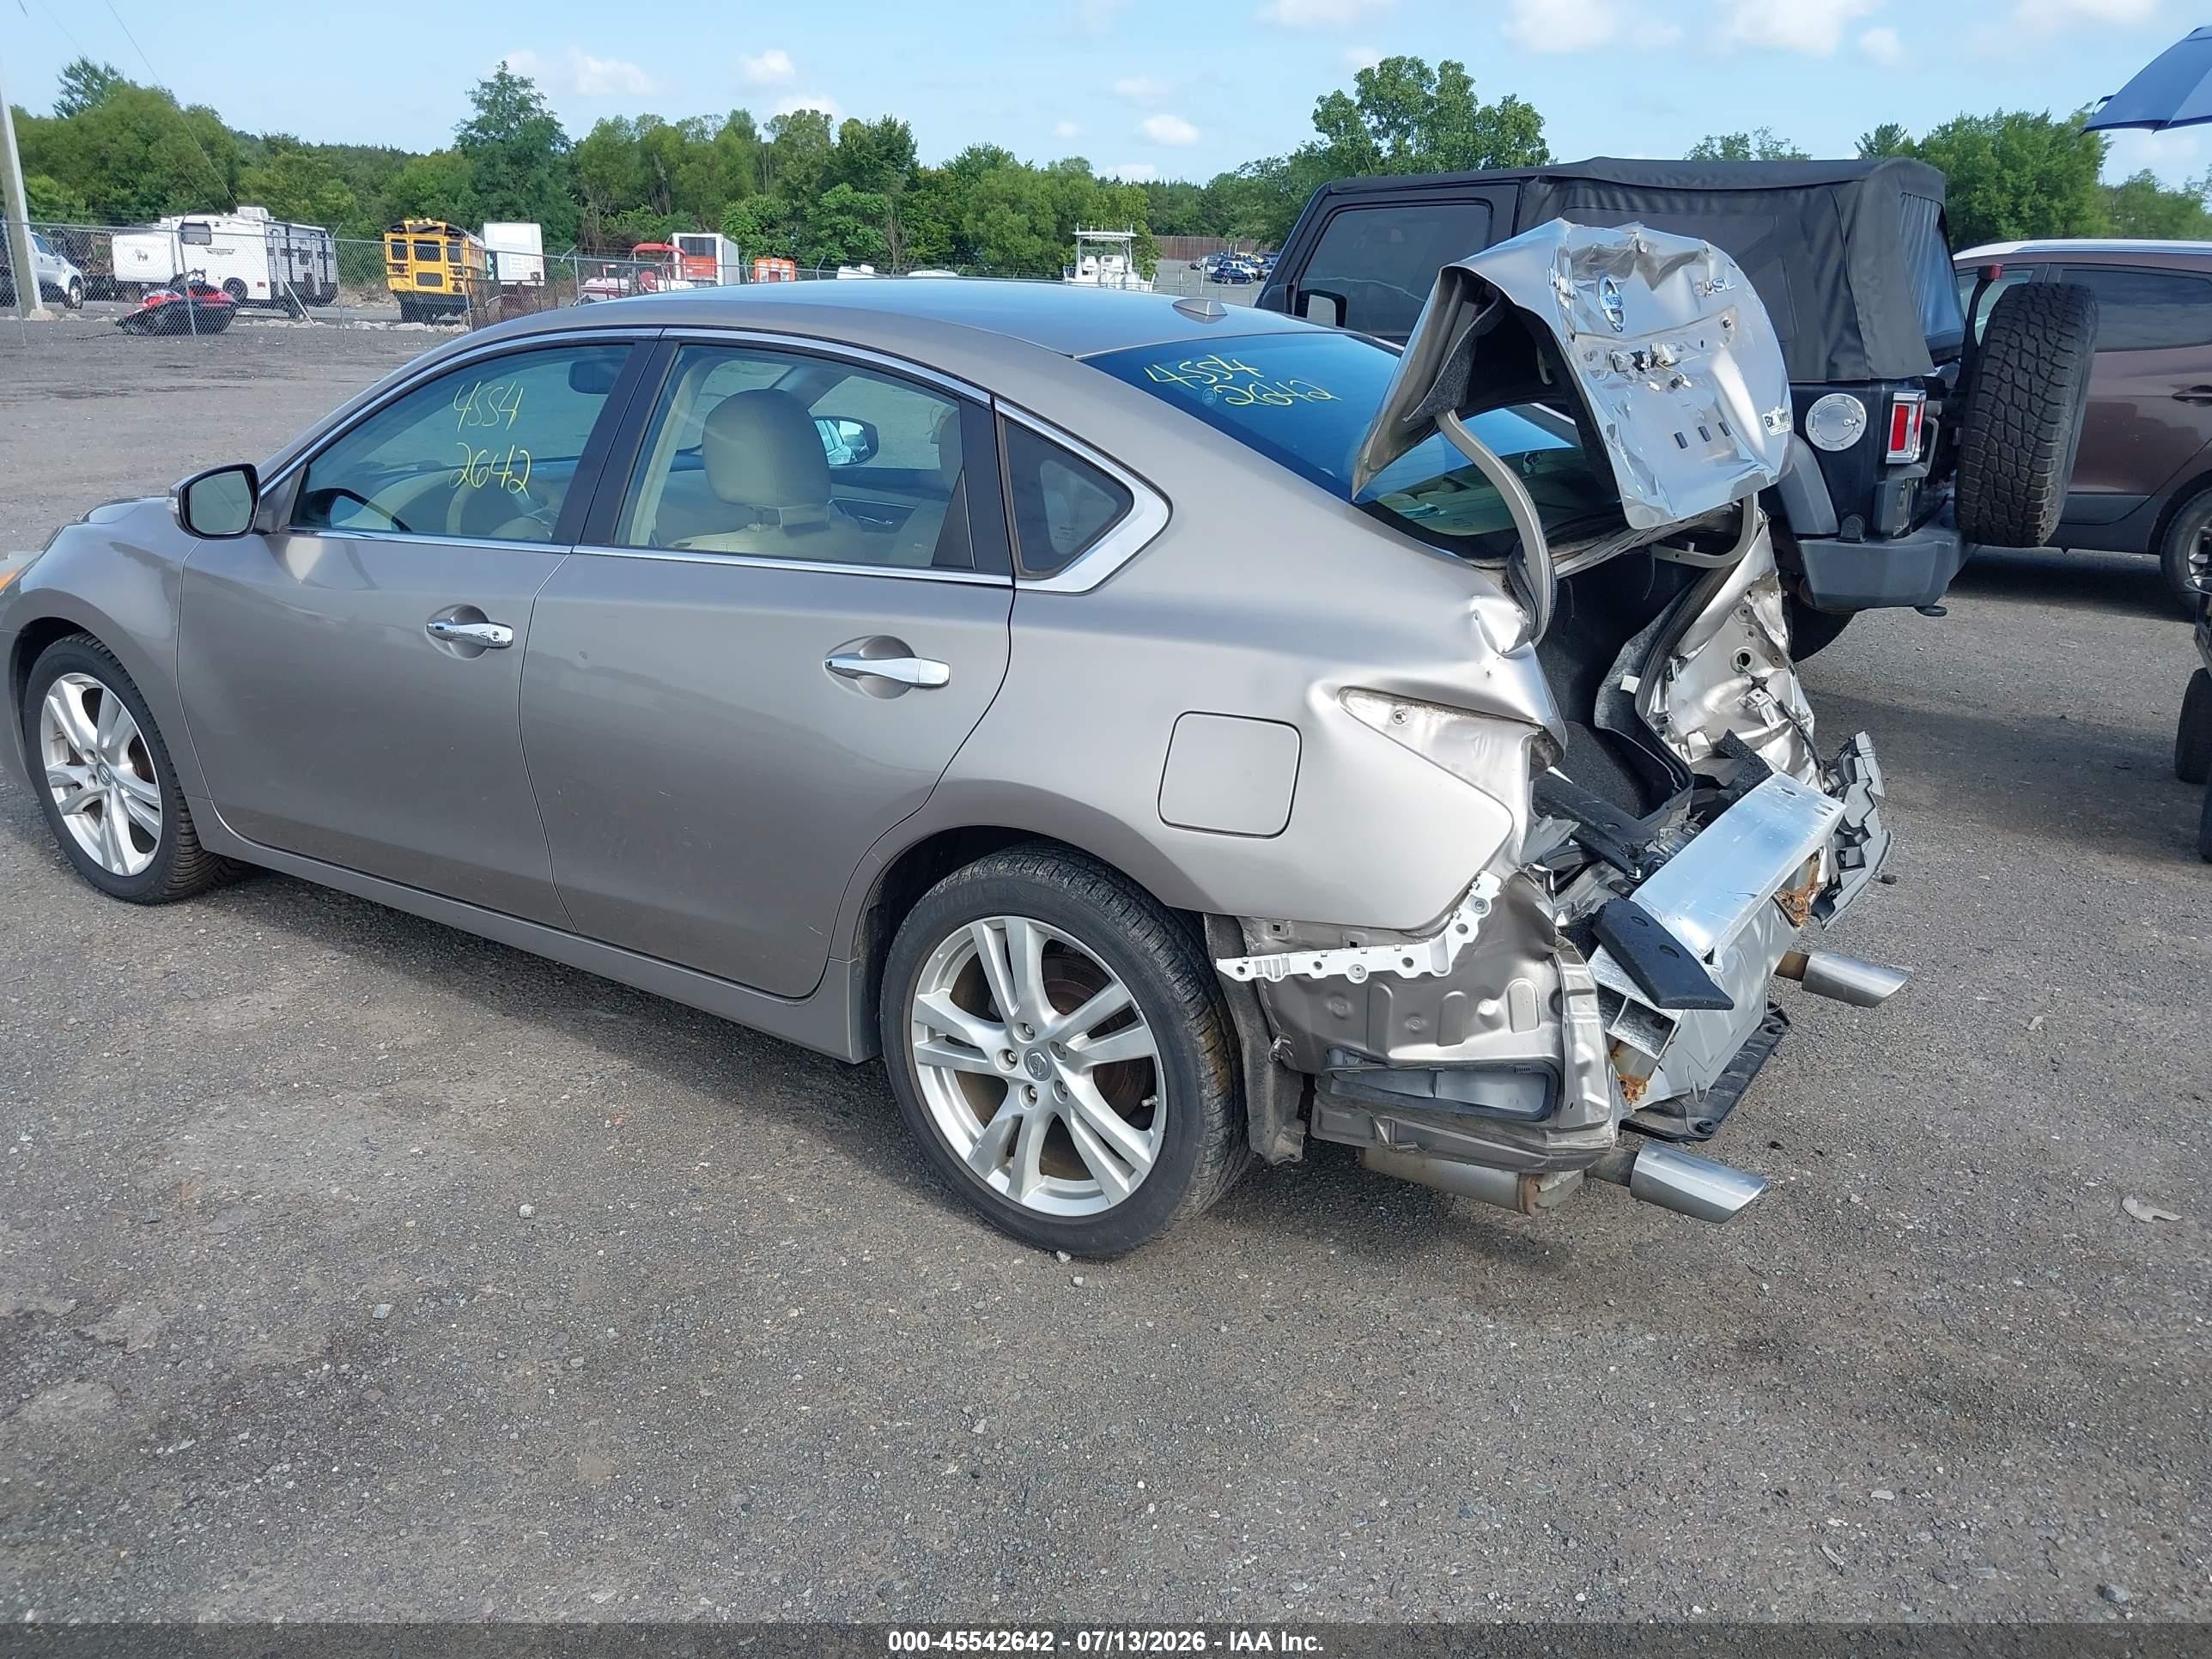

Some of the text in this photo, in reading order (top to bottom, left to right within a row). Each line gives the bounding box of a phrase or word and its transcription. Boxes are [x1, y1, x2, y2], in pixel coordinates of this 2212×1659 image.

[1143, 354, 1265, 390] 4554
[1213, 379, 1342, 406] 2642
[453, 380, 524, 432] 4554
[448, 441, 532, 499] 2642
